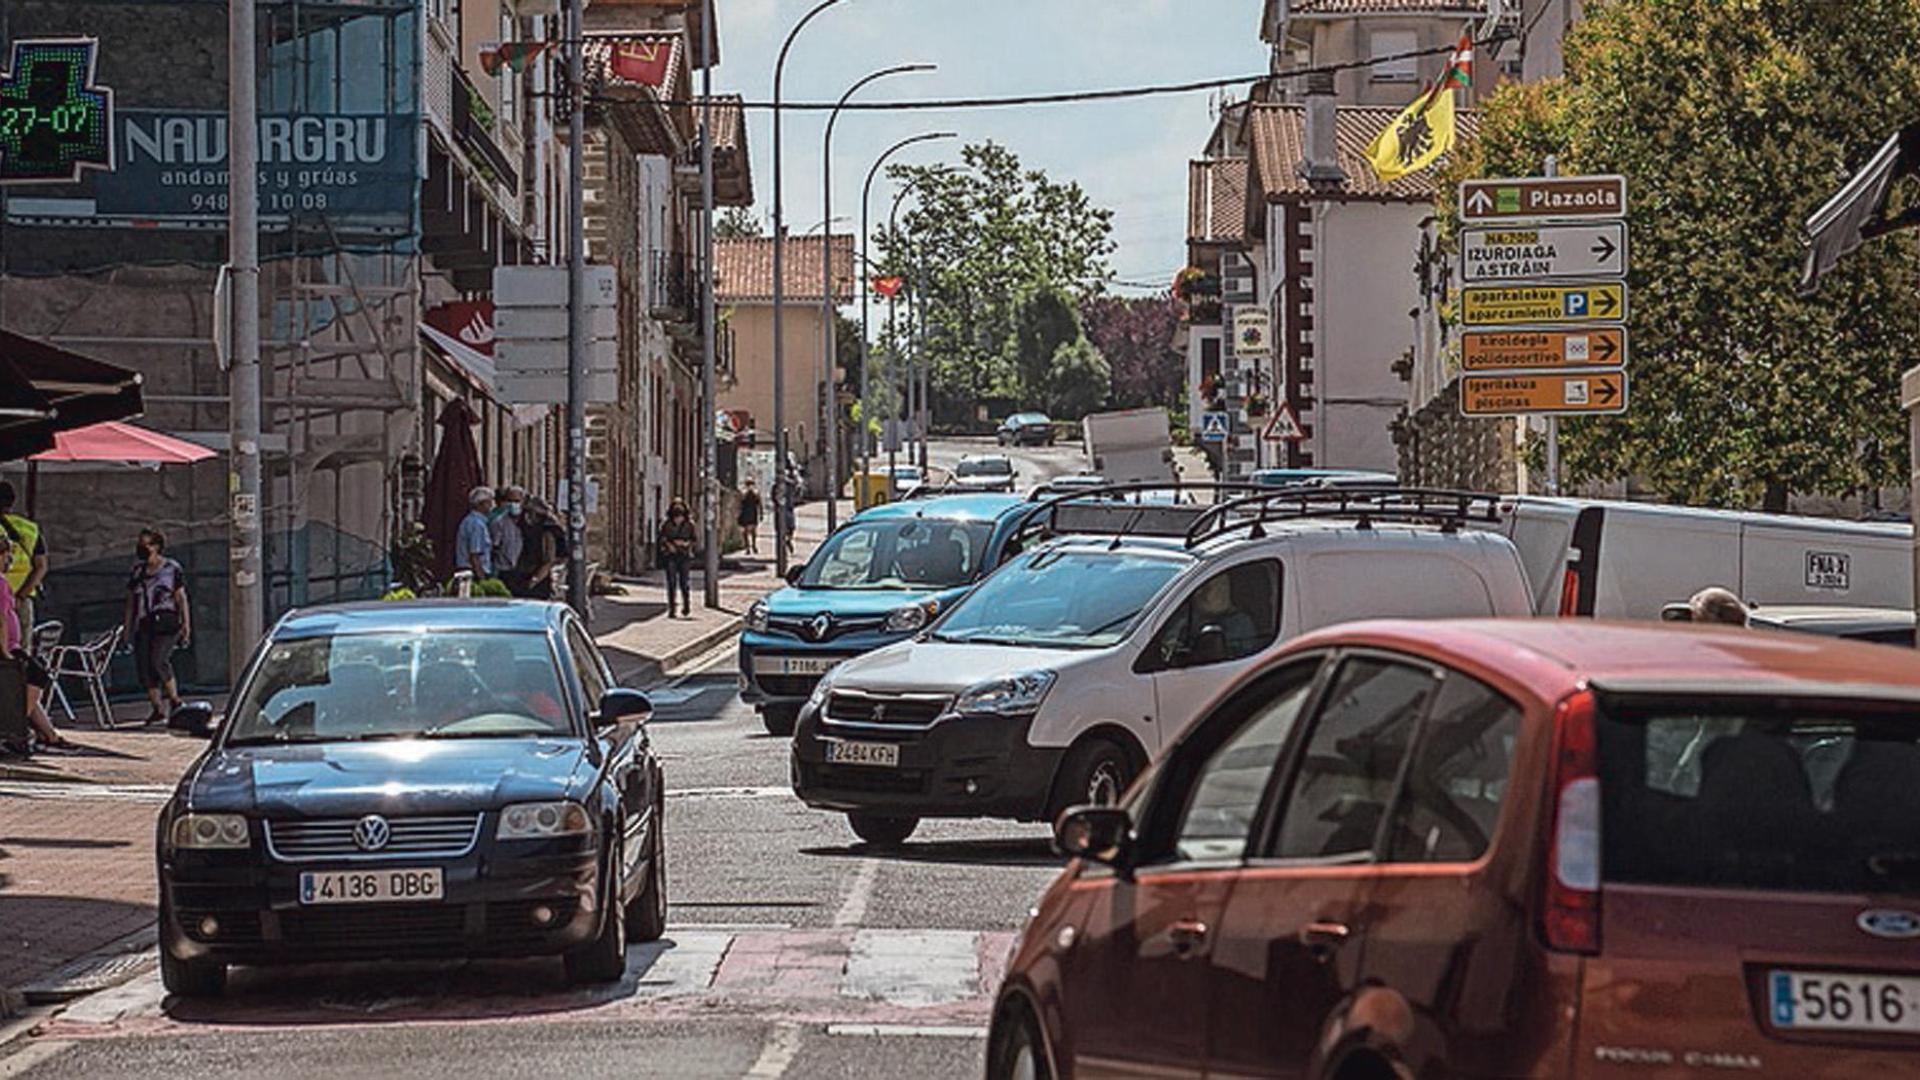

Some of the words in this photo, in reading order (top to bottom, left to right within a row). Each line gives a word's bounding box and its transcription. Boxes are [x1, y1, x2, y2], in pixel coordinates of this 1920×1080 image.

[2, 106, 87, 135] 27-07
[125, 117, 387, 163] NAVRGRU
[277, 174, 290, 188] y
[298, 166, 358, 188] grúas
[191, 193, 229, 210] 948
[271, 193, 294, 209] 10
[302, 193, 328, 209] 08
[1530, 189, 1617, 208] Plazaola
[1467, 244, 1557, 261] IZURDIAGA
[1472, 290, 1557, 304] aparkalekua
[1469, 307, 1562, 322] aparcamiento
[1469, 353, 1561, 367] polideportivo
[1475, 397, 1530, 411] piscinas
[320, 875, 377, 898] 4136
[390, 872, 435, 896] DBG
[1802, 980, 1904, 1022] 5616
